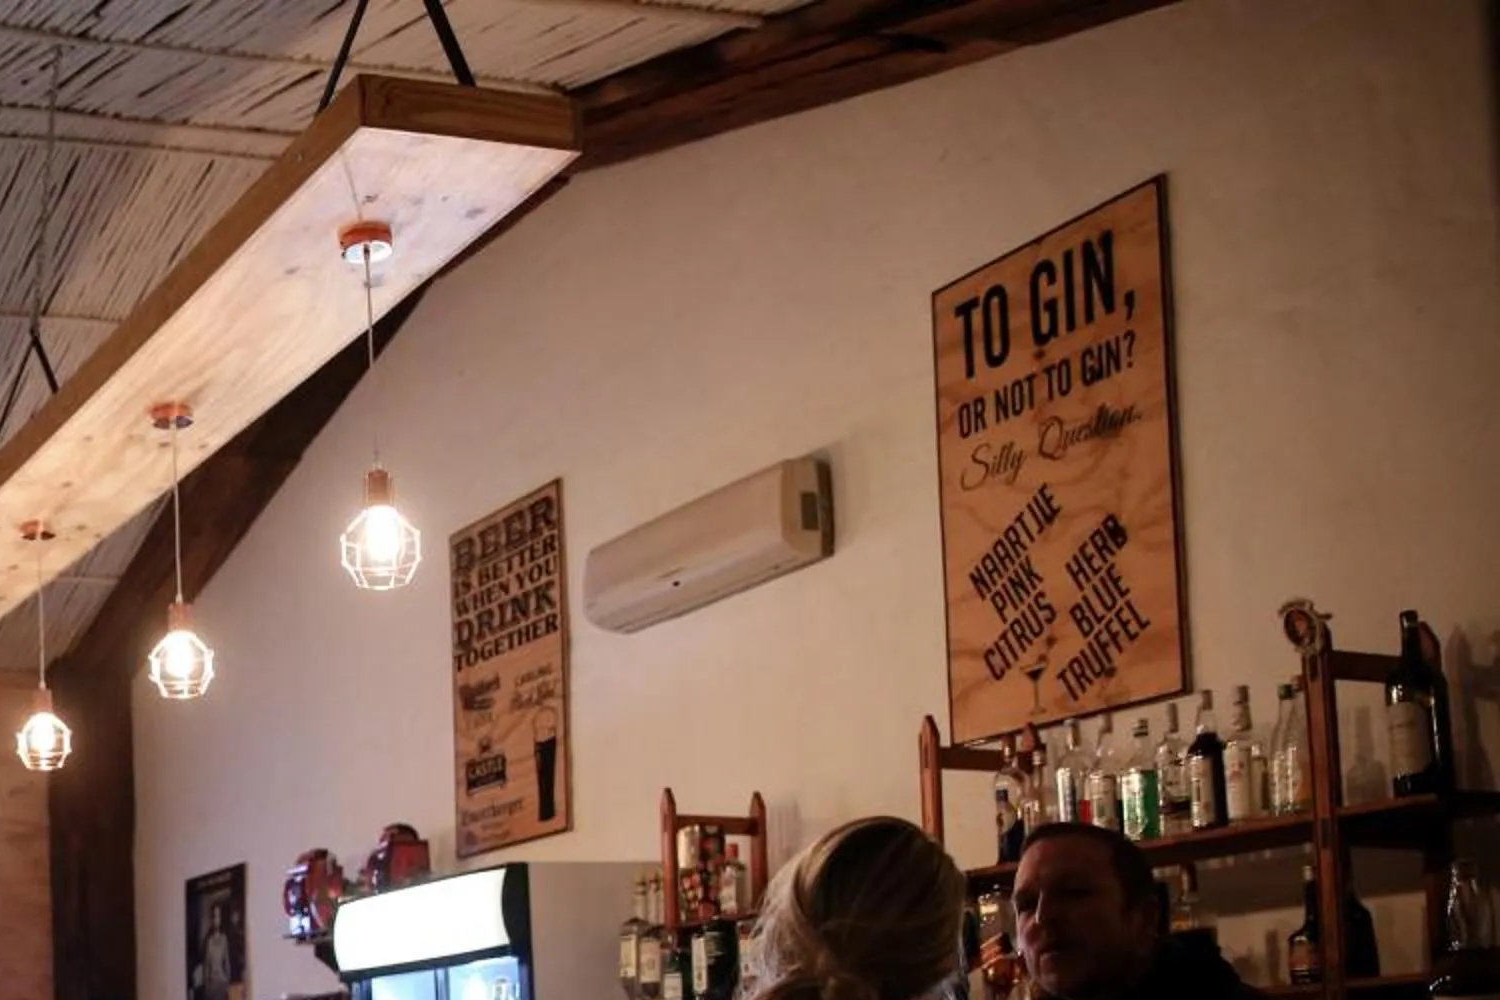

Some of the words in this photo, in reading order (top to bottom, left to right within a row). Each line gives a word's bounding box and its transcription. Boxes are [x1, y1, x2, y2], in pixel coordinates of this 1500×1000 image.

[954, 284, 1011, 380] TO
[1029, 228, 1136, 348] GIN,
[957, 396, 988, 440] OR
[994, 372, 1037, 425] NOT
[1043, 357, 1073, 402] TO
[1081, 329, 1137, 387] GIN?
[960, 441, 1027, 493] Silly
[451, 495, 557, 574] BEER
[478, 533, 557, 586] BETTER
[968, 483, 1062, 602] NAARTJIE
[1065, 513, 1129, 592] HERB
[454, 579, 555, 650] DRINK
[455, 581, 511, 619] WHEN
[516, 554, 558, 589] YOU
[990, 555, 1044, 625] PINK
[1068, 563, 1130, 639] BLUE
[453, 613, 559, 673] TOGETHER
[982, 590, 1058, 682] CITRUS
[1056, 600, 1151, 702] TRUFFEL
